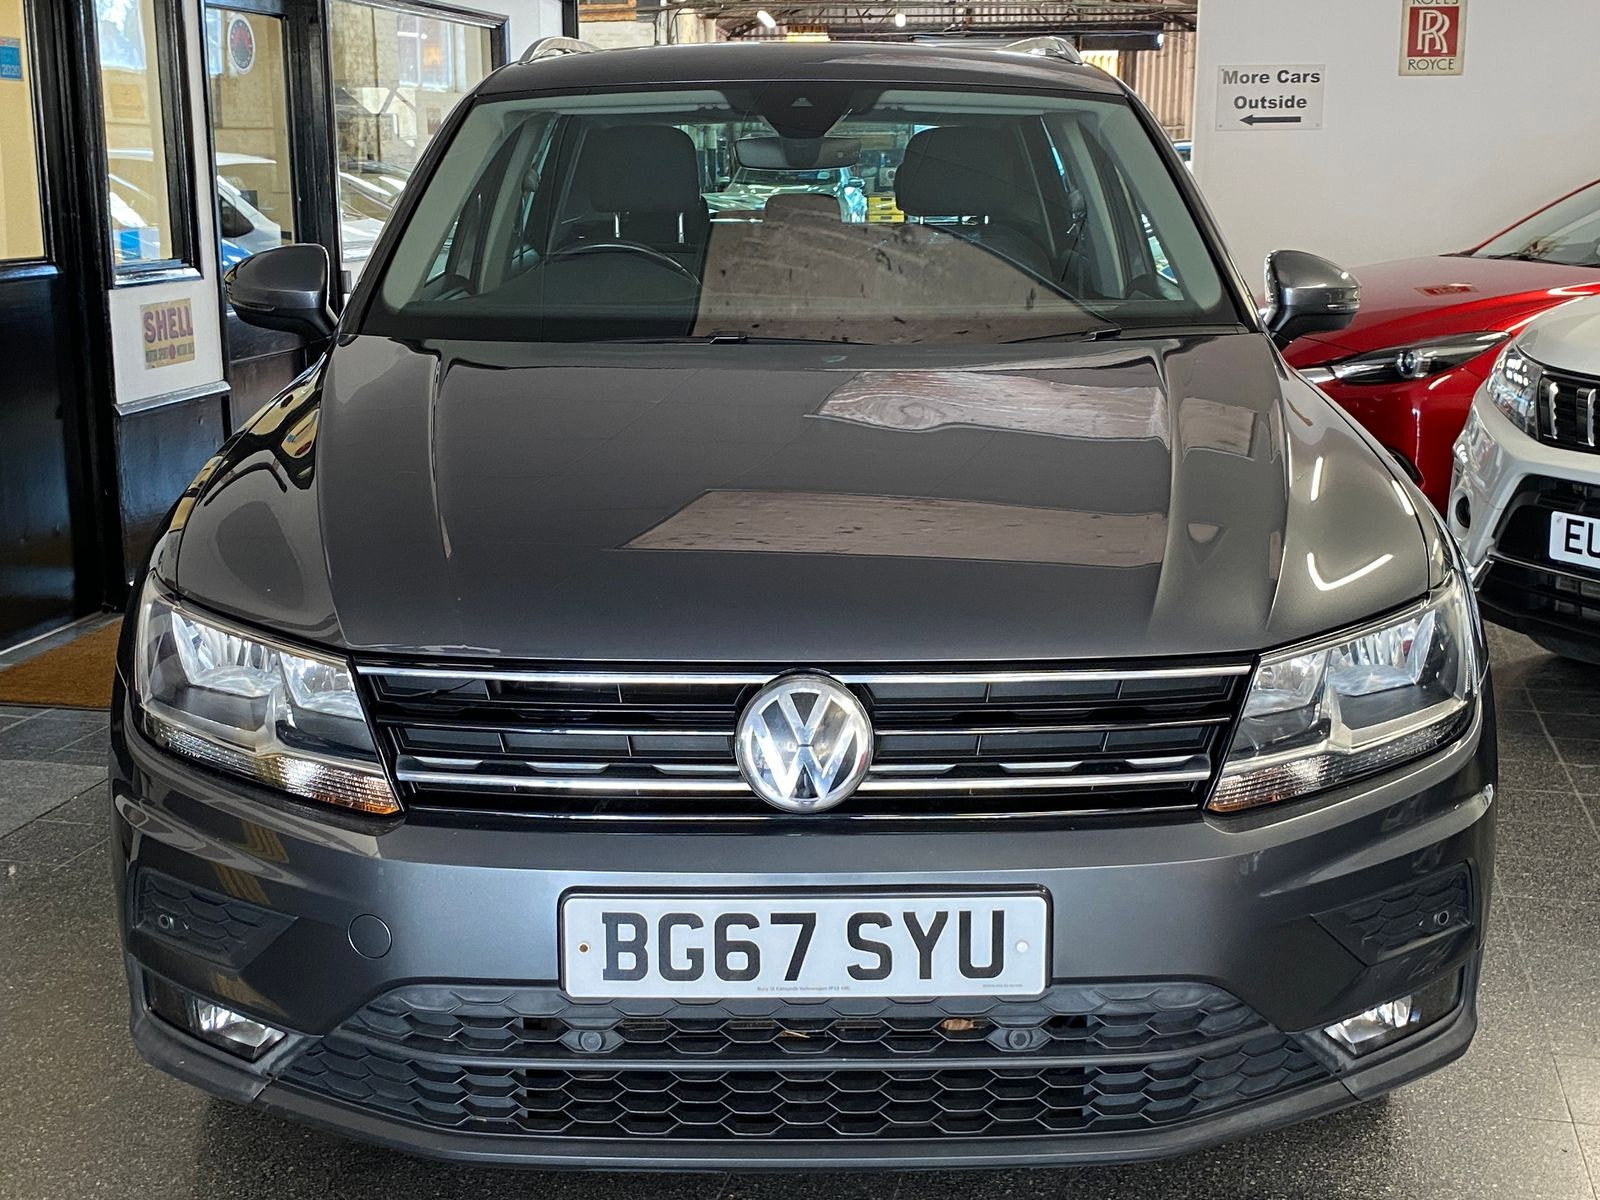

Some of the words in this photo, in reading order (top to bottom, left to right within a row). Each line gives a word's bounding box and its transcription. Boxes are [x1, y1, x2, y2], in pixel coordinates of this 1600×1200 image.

[1222, 70, 1270, 85] More
[1277, 69, 1321, 84] Cars
[1407, 59, 1455, 71] ROYCE
[1233, 95, 1307, 110] Outside
[143, 305, 194, 344] SHELL
[1564, 517, 1600, 559] EU
[601, 911, 817, 982] BG67
[846, 910, 1005, 981] SYU
